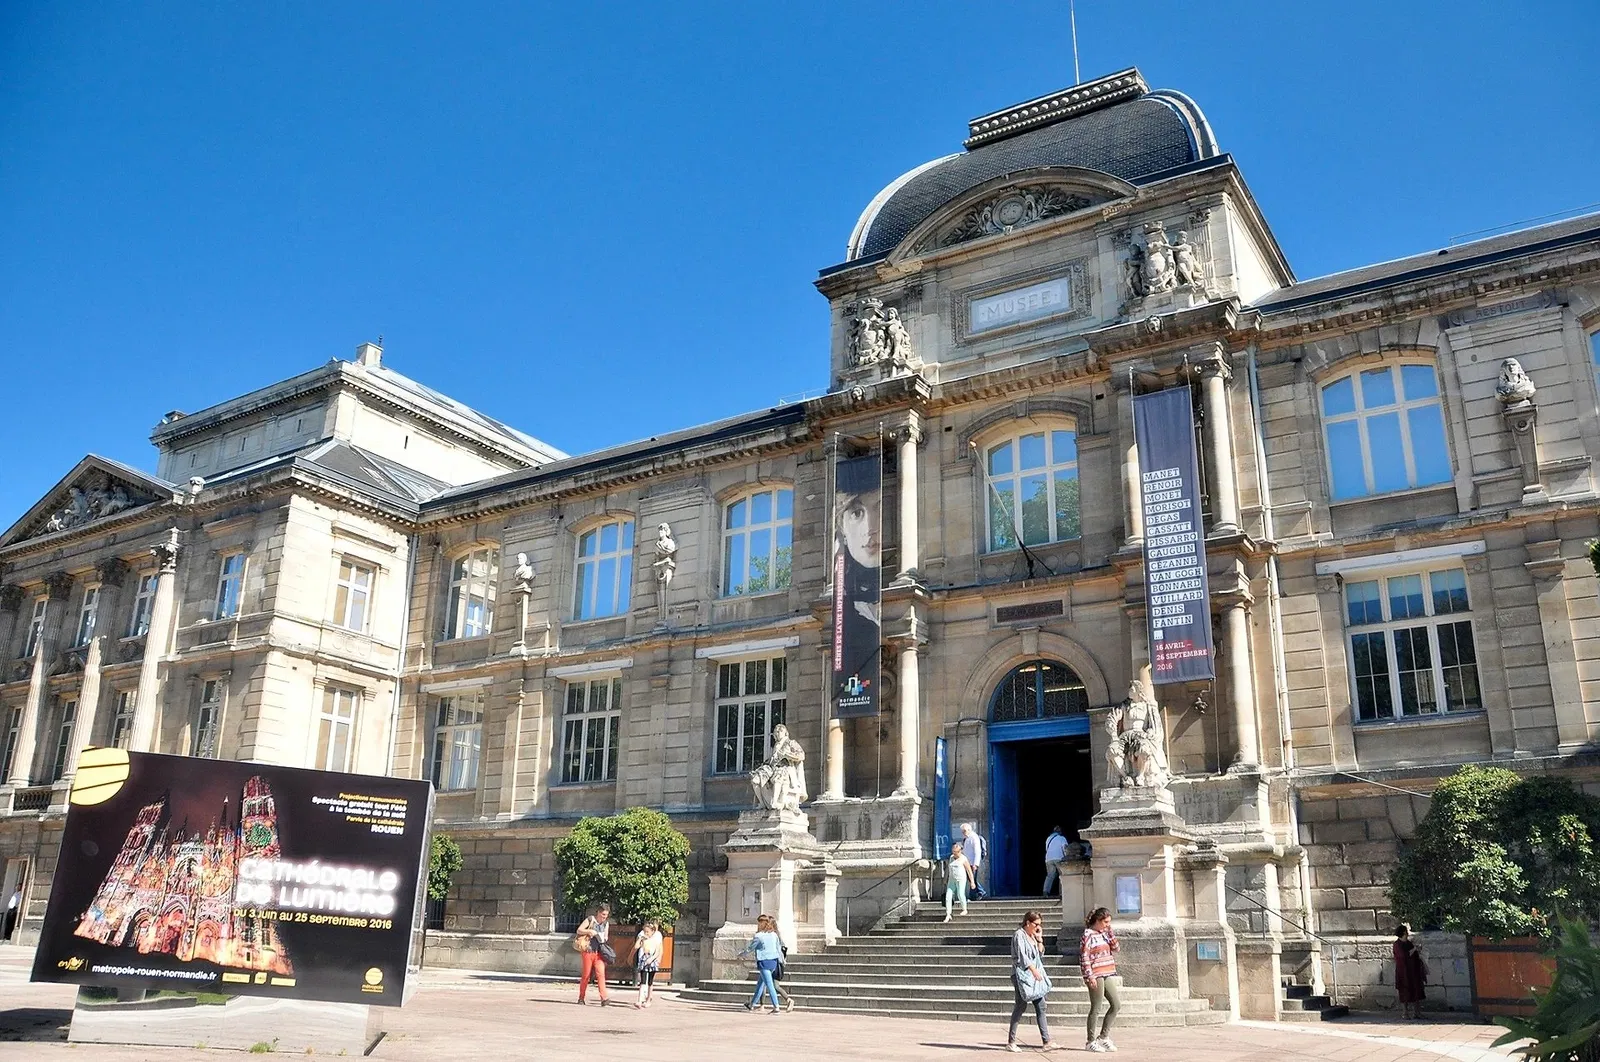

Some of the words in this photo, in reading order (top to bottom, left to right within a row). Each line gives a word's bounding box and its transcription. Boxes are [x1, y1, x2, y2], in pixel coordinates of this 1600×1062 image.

[1475, 300, 1526, 318] RESTOUT
[1144, 468, 1179, 481] MANET
[1145, 479, 1182, 492] RENOIR
[1146, 490, 1180, 502] MONET
[1147, 500, 1190, 513] MORISOT
[1147, 513, 1179, 525] DEGAS
[1148, 522, 1190, 535] CASSATT
[1149, 533, 1197, 546] PISSARRO
[1149, 544, 1194, 558] GAUGUIN
[1151, 572, 1171, 581] VAN
[1175, 568, 1202, 578] GOGH
[1152, 579, 1201, 592] BONNARD
[1153, 590, 1203, 604] VUILLARD
[1153, 604, 1184, 616] DENIS
[1154, 616, 1192, 627] FANTIN
[836, 635, 842, 644] DE
[1165, 642, 1185, 650] AVRIL
[1166, 649, 1208, 660] SEPTEMBRE
[1157, 663, 1173, 671] 2016
[312, 796, 348, 806] Spectacle
[374, 802, 389, 810] tout
[339, 792, 369, 801] Projections
[346, 815, 363, 823] Parvis
[371, 824, 404, 835] ROUEN
[233, 909, 247, 917] DU
[248, 909, 255, 917] 3
[295, 912, 308, 922] 25
[369, 918, 392, 929] 2016
[92, 964, 217, 981] metropole-rouen-normandie.fr
